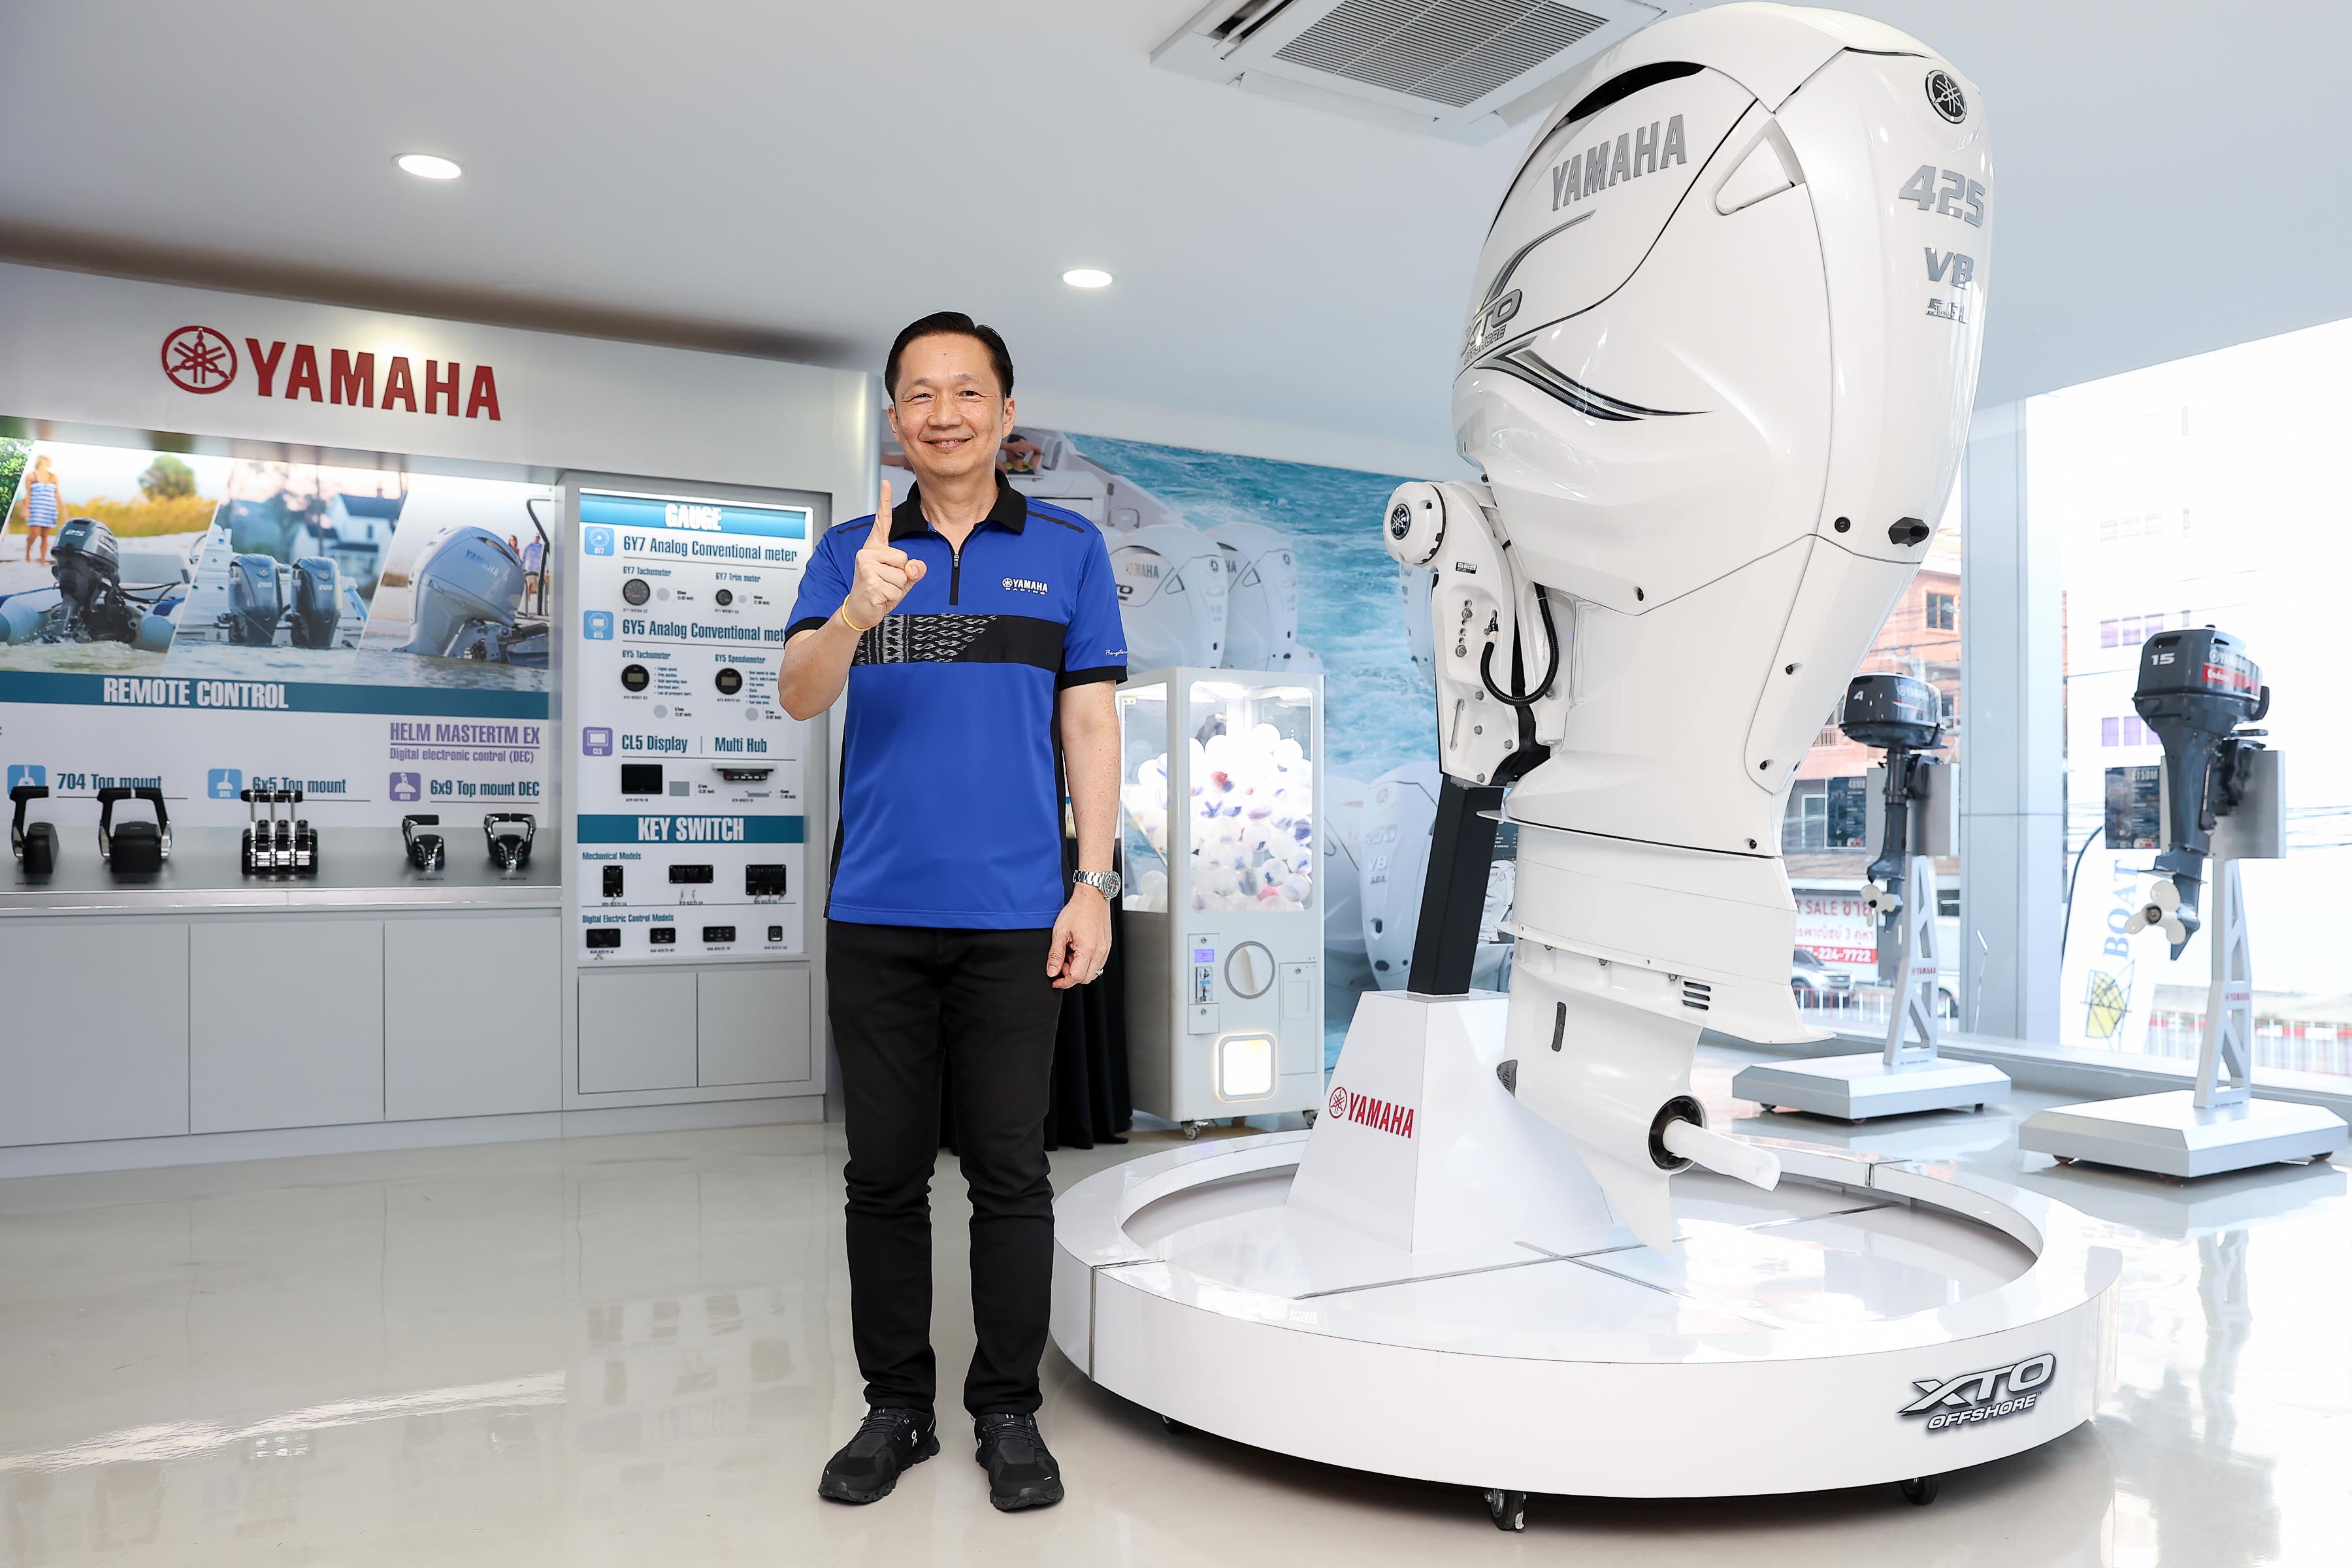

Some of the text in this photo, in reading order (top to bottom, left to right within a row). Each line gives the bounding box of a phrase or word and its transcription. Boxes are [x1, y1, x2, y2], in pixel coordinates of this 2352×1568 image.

[1552, 114, 1687, 211] YAMAHA
[1899, 165, 1985, 228] 425
[1924, 247, 1974, 290] V8
[246, 337, 502, 421] YAMAHA
[664, 503, 722, 531] GAUGE
[624, 536, 797, 562] 6Y7 Analog Conventional meter
[636, 567, 672, 576] Tachometer
[1013, 579, 1048, 592] YAMAHA
[623, 619, 785, 642] 6Y5 Analog Conventional met
[636, 651, 671, 660] Tachometer
[728, 655, 766, 664] Speedometer
[2151, 653, 2176, 666] 15
[103, 678, 289, 709] REMOTE CONTROL
[1854, 691, 1864, 700] 4
[390, 723, 540, 744] HELM MASTERTM EX
[622, 734, 688, 753] CL5 Display
[715, 737, 767, 753] Multi Hub
[390, 747, 534, 764] Digital electronic control (DEC)
[57, 773, 162, 789] 704 Top mount
[253, 776, 347, 793] 6x5 Top mount
[431, 779, 540, 797] 6x9 Top mount DEC
[638, 817, 744, 841] KEY SWITCH
[582, 851, 642, 860] Mechanical Models
[1806, 900, 1838, 915] SALE
[2103, 859, 2140, 960] BOAT
[582, 913, 674, 924] Digital Electric Control Models
[1348, 1092, 1414, 1139] YAMAHA
[1897, 1353, 2056, 1416] XTO
[1927, 1392, 2037, 1430] OFFSHORE
